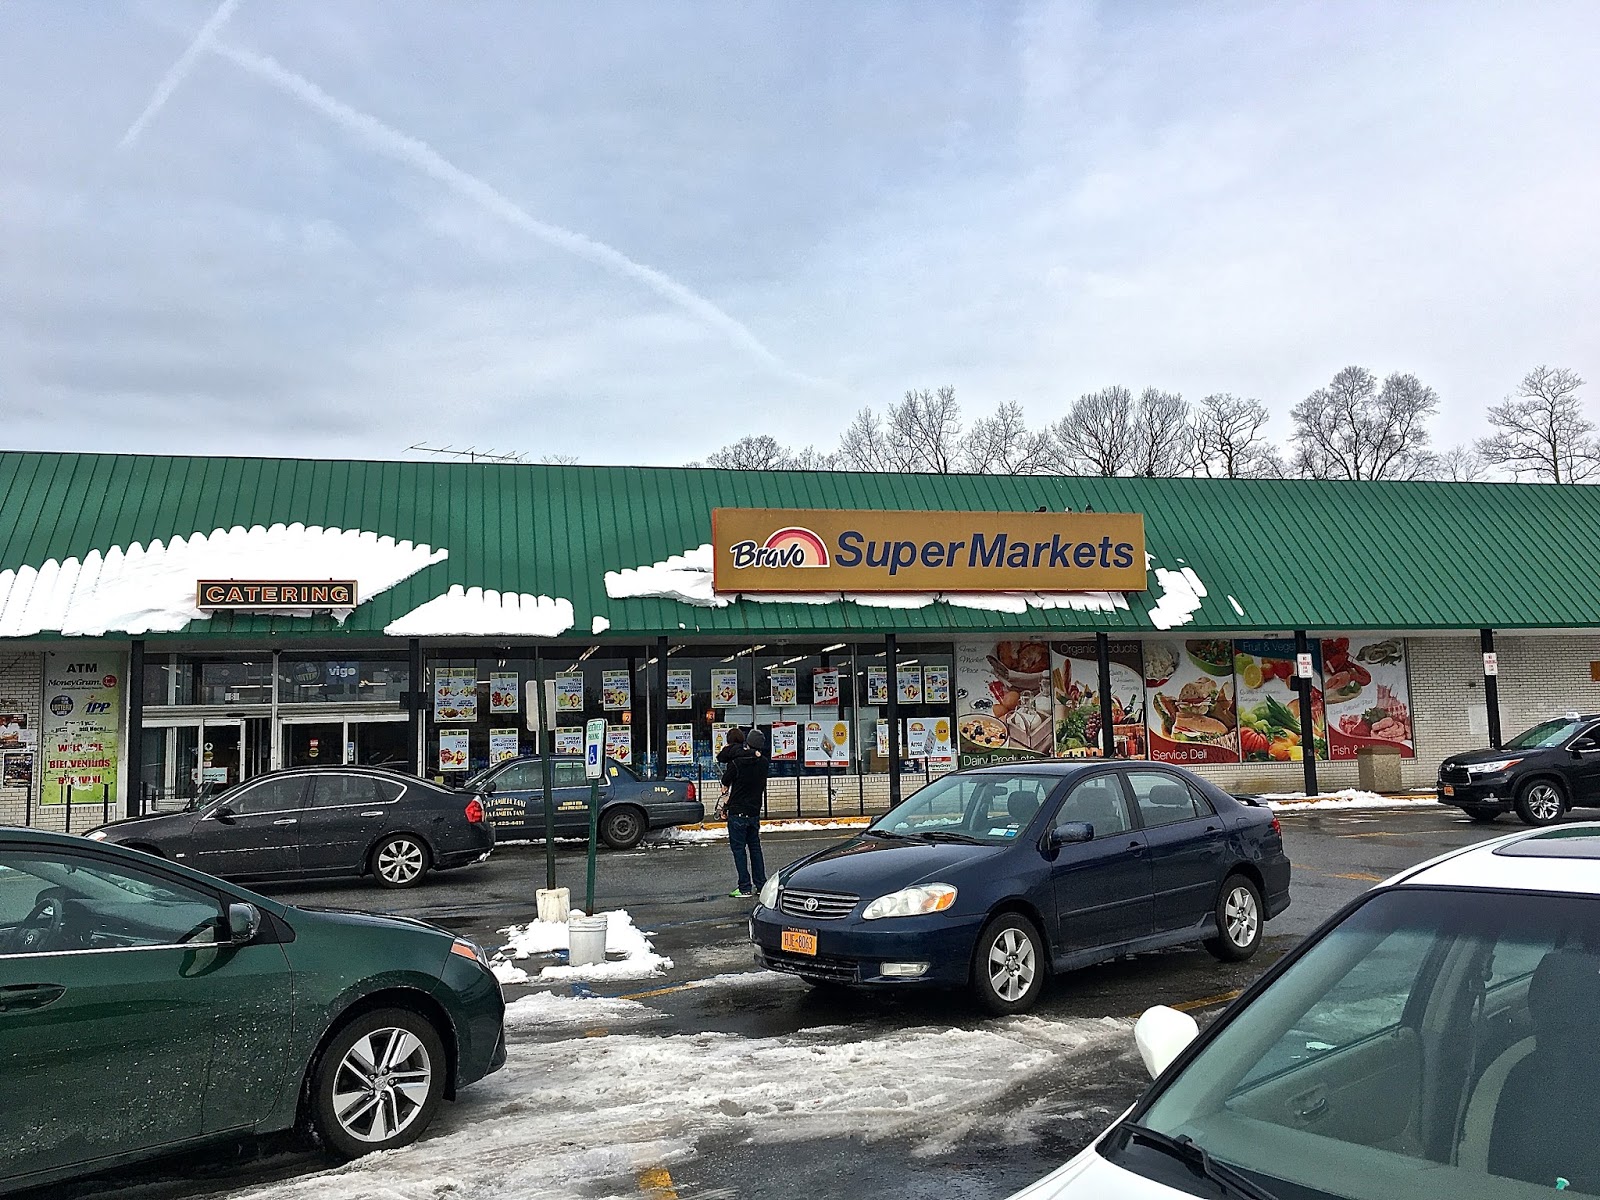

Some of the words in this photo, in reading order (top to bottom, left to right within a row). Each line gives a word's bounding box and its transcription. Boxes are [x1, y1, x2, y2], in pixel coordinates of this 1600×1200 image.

[730, 539, 805, 568] Bravo
[206, 586, 348, 603] CATERING
[1060, 643, 1096, 656] Organic
[1243, 641, 1261, 652] Fruit
[1263, 641, 1271, 652] &
[1271, 641, 1315, 653] Vegetle
[66, 663, 98, 673] ATM
[328, 665, 357, 678] vigo
[86, 702, 111, 713] IPP
[1152, 749, 1188, 761] Service
[1190, 748, 1207, 760] Deli
[1331, 744, 1350, 756] Fish
[963, 755, 988, 767] Dairy
